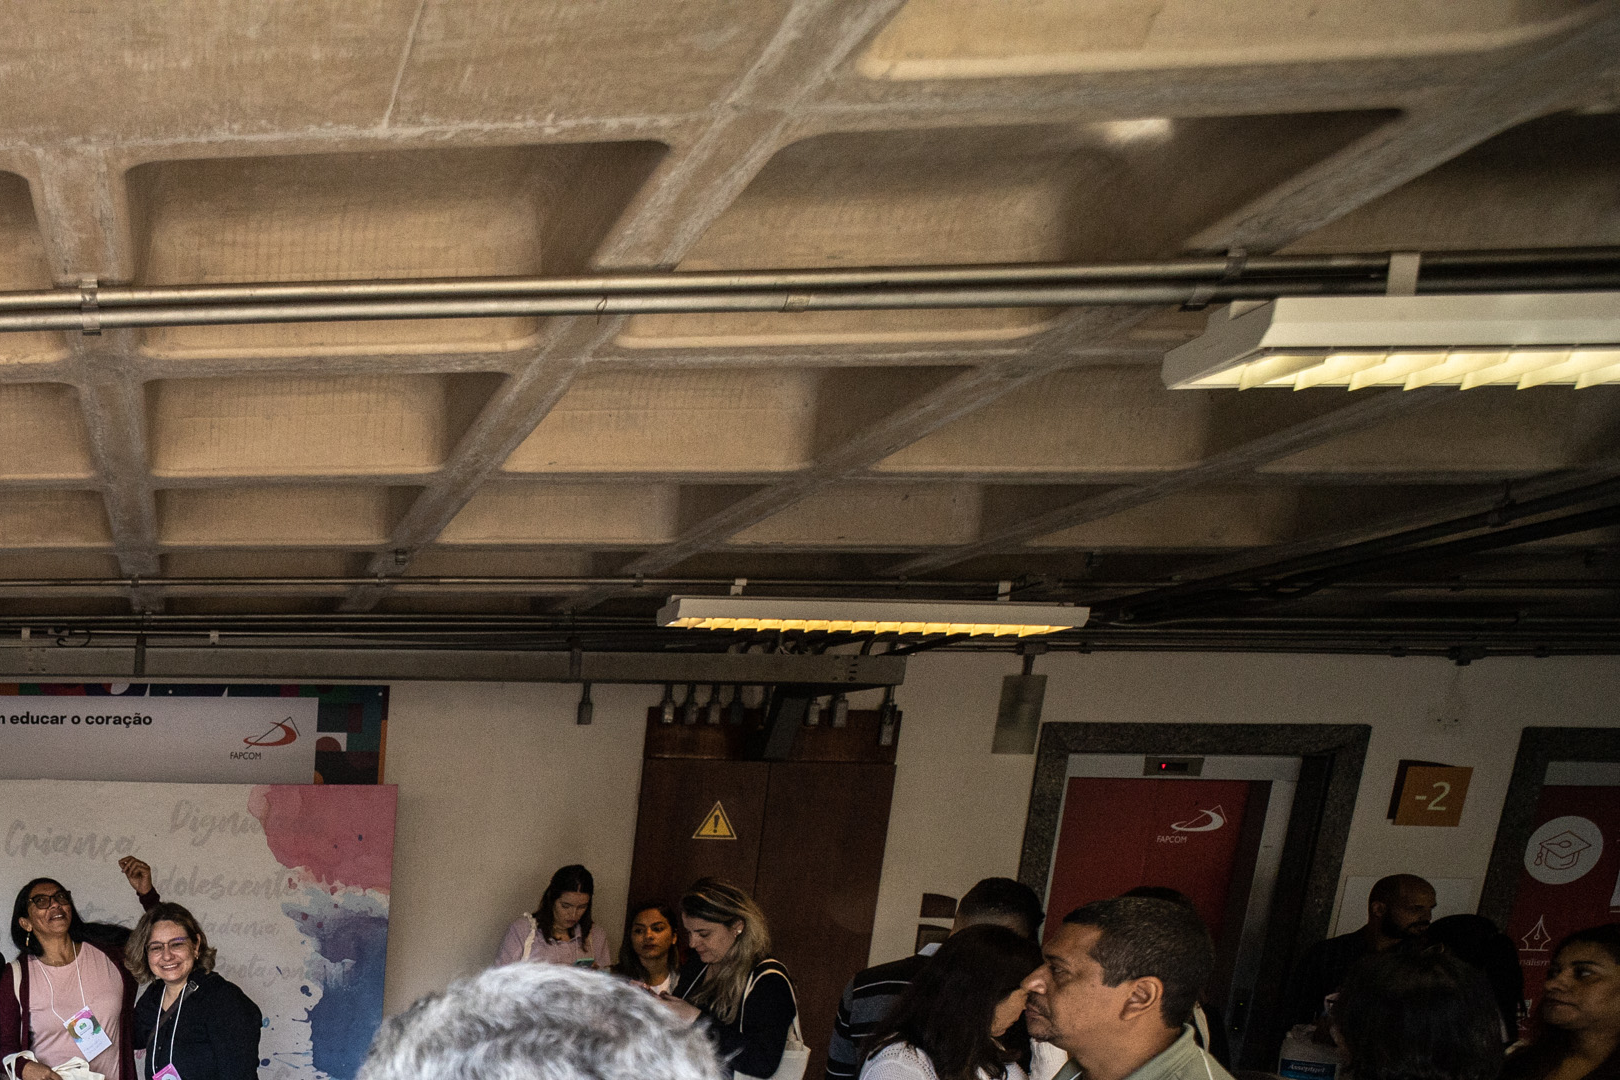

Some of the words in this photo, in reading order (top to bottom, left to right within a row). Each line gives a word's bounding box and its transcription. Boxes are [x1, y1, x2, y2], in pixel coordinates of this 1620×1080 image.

[9, 712, 67, 726] educar
[70, 714, 82, 726] o
[84, 712, 153, 729] coração
[229, 751, 262, 760] FAPCOM
[1414, 780, 1451, 812] -2
[4, 819, 141, 862] Criança
[1156, 835, 1188, 844] FAPCOM
